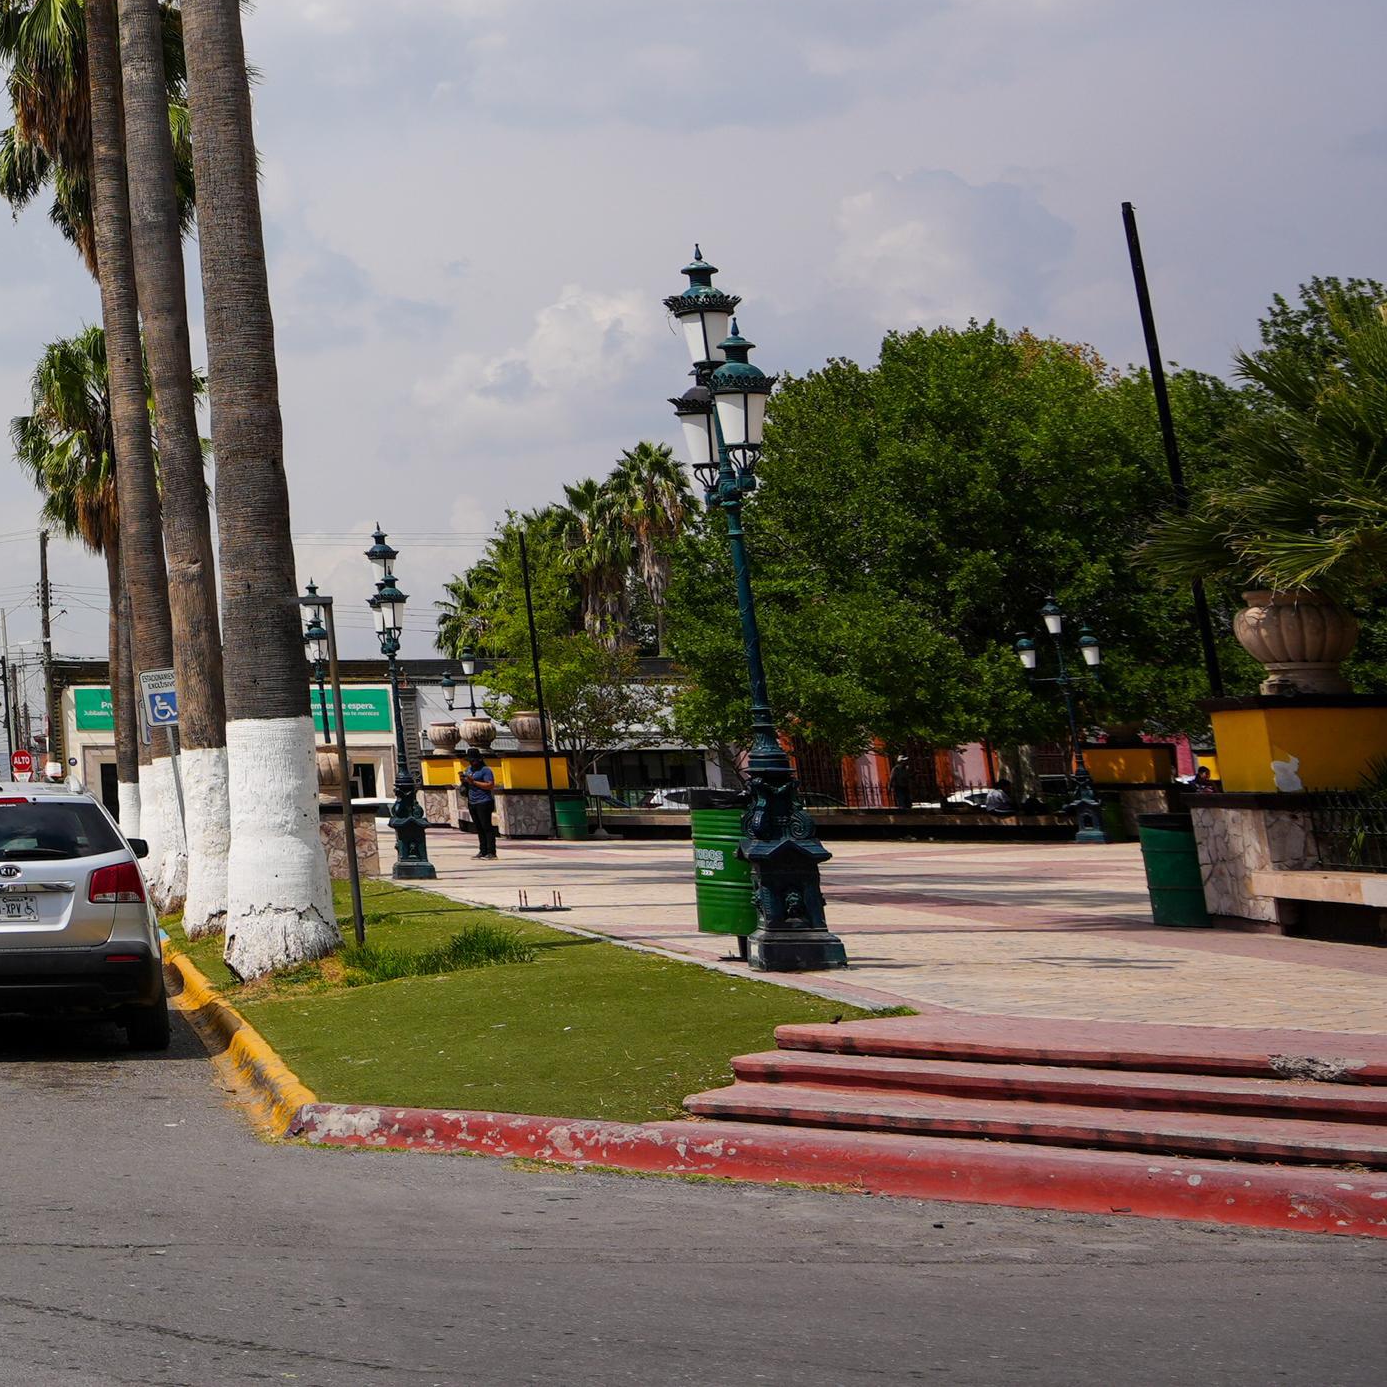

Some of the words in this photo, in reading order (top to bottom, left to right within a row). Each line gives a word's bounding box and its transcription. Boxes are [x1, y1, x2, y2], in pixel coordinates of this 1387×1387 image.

[347, 702, 376, 711] espera.
[14, 756, 30, 765] ALTO
[1, 868, 17, 876] KIA
